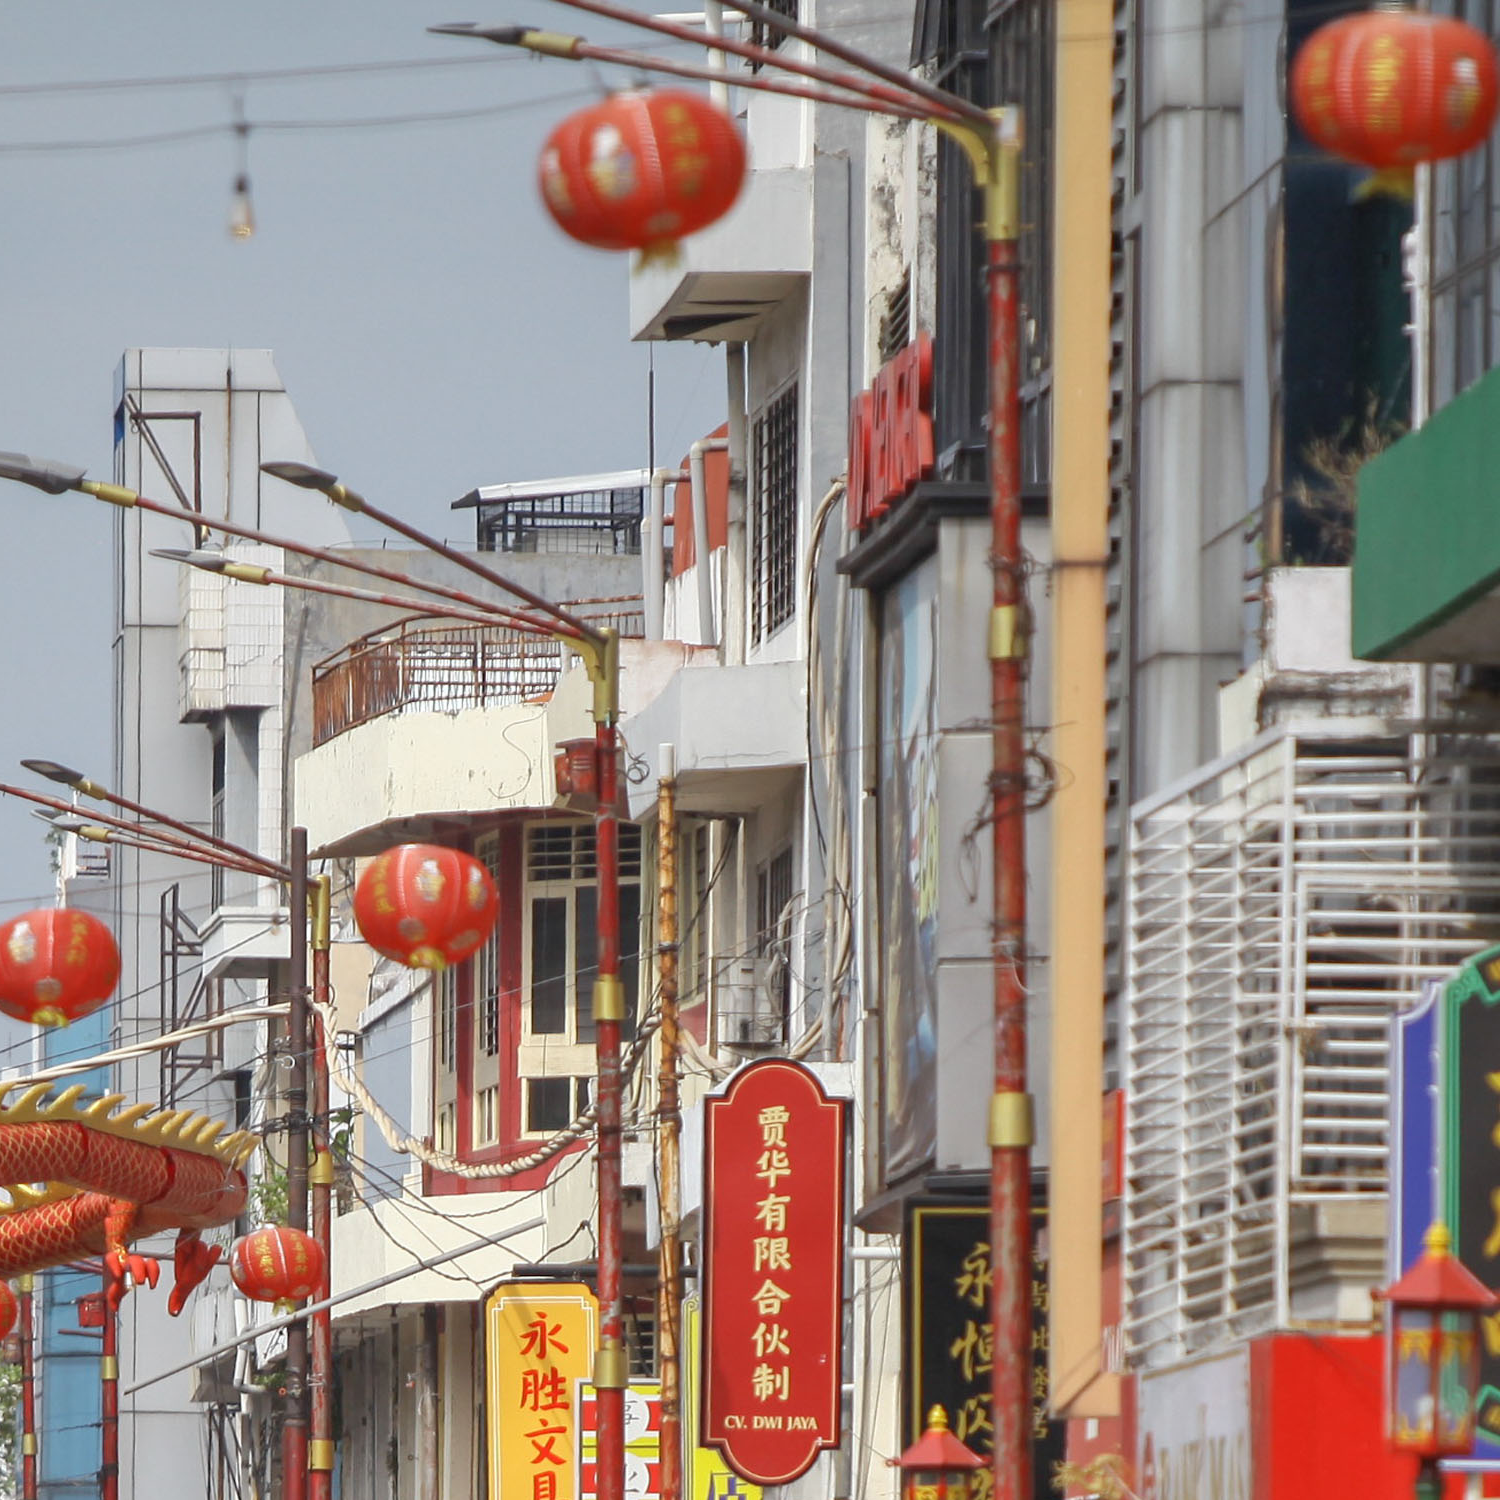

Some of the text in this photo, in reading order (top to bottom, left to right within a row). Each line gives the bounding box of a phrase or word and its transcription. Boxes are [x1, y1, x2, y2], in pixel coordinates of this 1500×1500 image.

[750, 1104, 792, 1402] 贾华有限合伙制
[724, 1415, 818, 1431] CV. DWI JAYA
